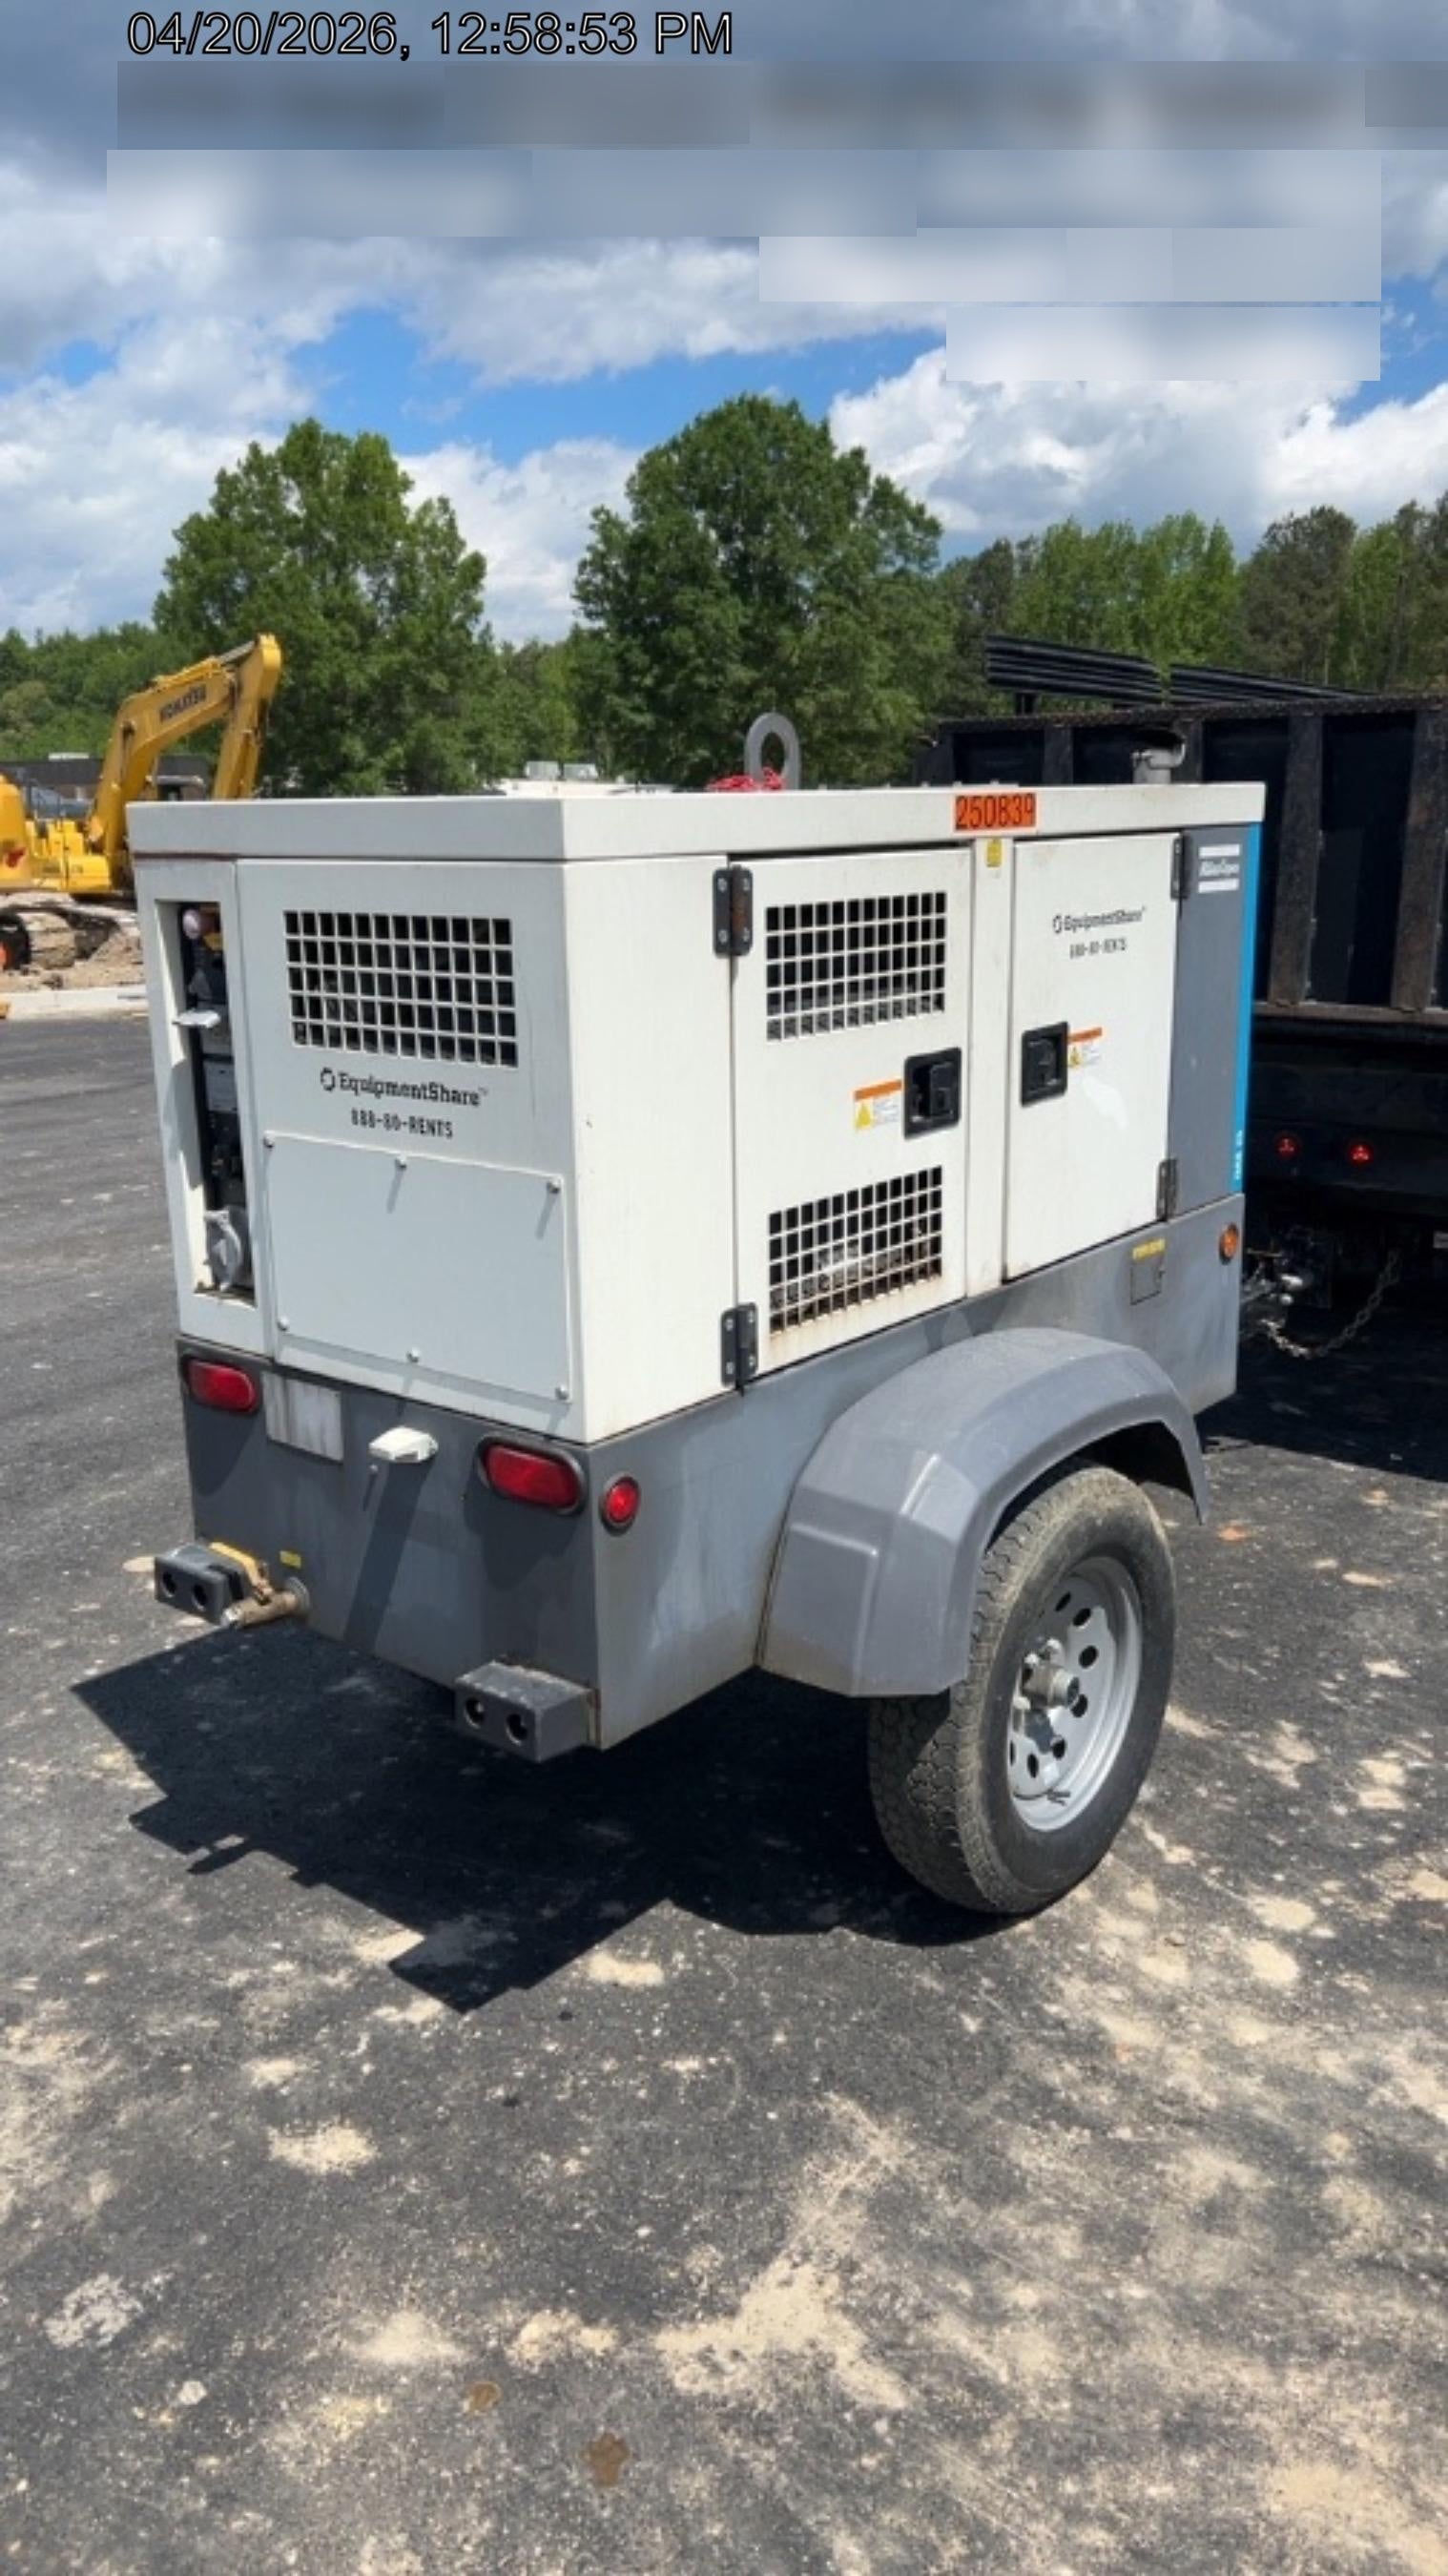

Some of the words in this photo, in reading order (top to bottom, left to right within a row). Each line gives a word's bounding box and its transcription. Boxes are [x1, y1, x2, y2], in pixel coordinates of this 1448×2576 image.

[956, 795, 1035, 829] 250839
[338, 1071, 482, 1107] EquipmentShare
[350, 1107, 453, 1139] 888-80-RENTS
